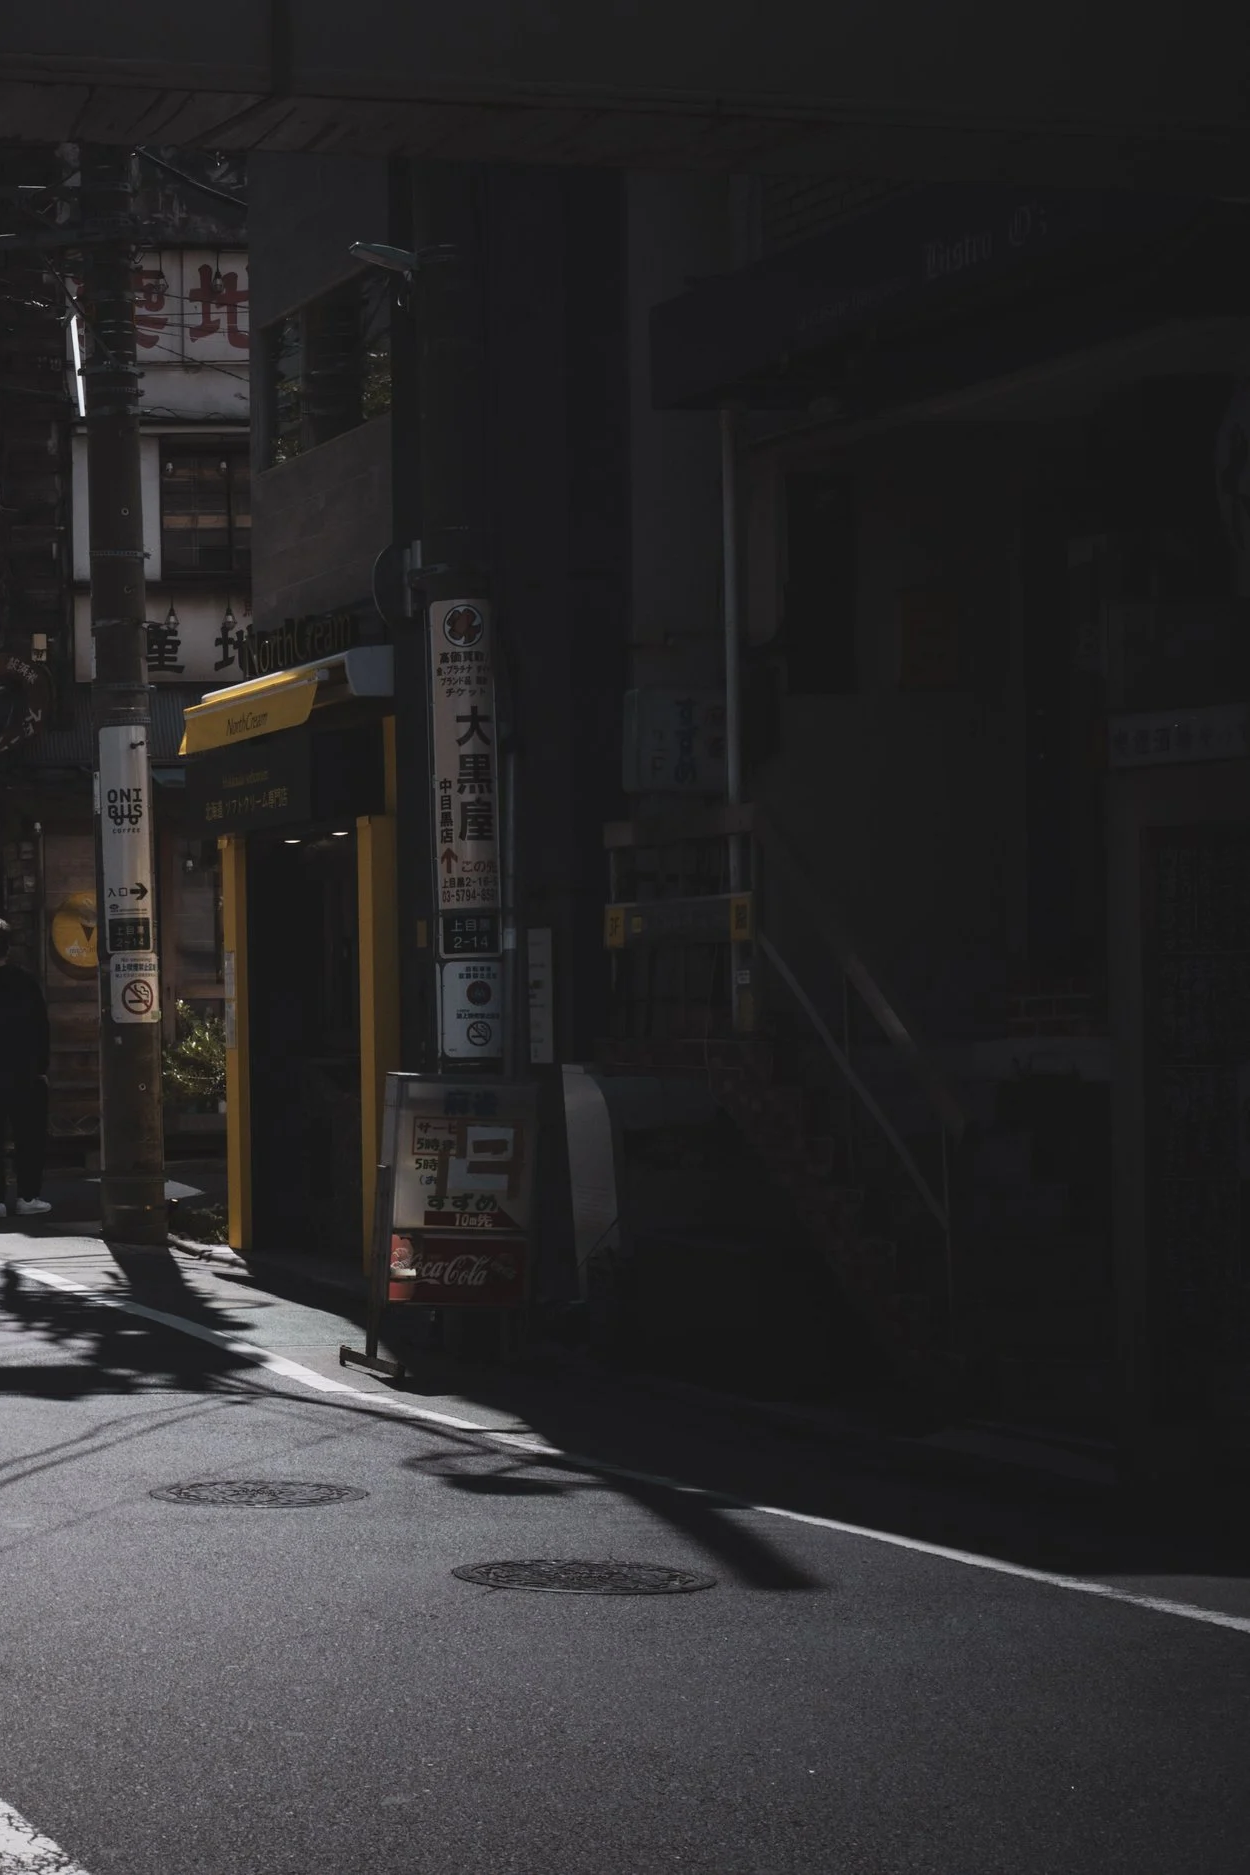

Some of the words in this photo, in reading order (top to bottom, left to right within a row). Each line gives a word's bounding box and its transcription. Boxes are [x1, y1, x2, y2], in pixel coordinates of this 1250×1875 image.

[455, 705, 495, 842] 大黒屋
[107, 788, 143, 804] ONI
[107, 804, 143, 826] BUS
[439, 778, 454, 844] 中目黒店
[108, 887, 128, 898] 入口
[450, 918, 492, 932] 上目黒
[452, 936, 489, 949] 2-14
[454, 1212, 494, 1228] 10m先
